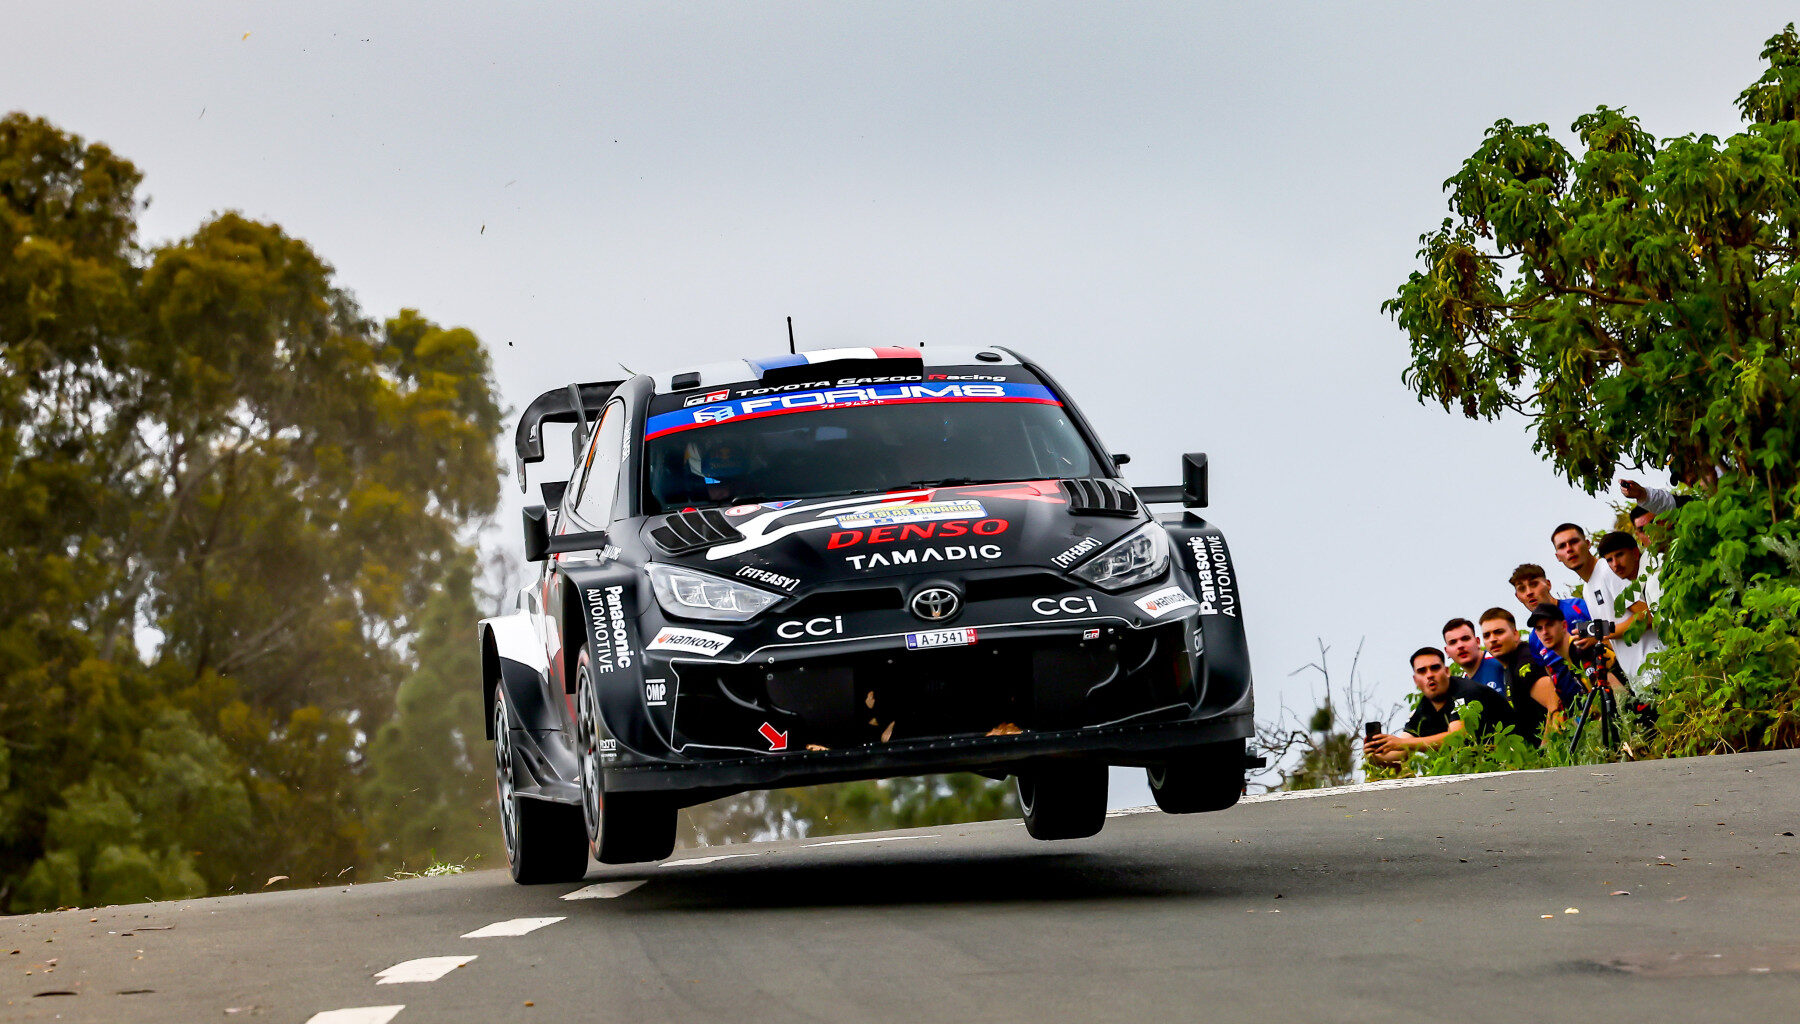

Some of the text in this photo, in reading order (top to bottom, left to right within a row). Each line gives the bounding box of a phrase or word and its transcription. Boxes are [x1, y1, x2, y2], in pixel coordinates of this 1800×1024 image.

[735, 373, 1007, 397] TOYOTA GAZOO Racing
[740, 384, 1006, 415] FORUM8
[827, 518, 1010, 550] DENSO
[845, 544, 1002, 570] TAMADIC
[1187, 536, 1218, 615] Panasonic
[1206, 535, 1236, 617] AUTOMOTIVE
[586, 588, 614, 673] AUTOMOTIVE
[604, 585, 634, 668] Panasonic
[921, 632, 963, 645] A-7541
[646, 684, 666, 701] OMP
